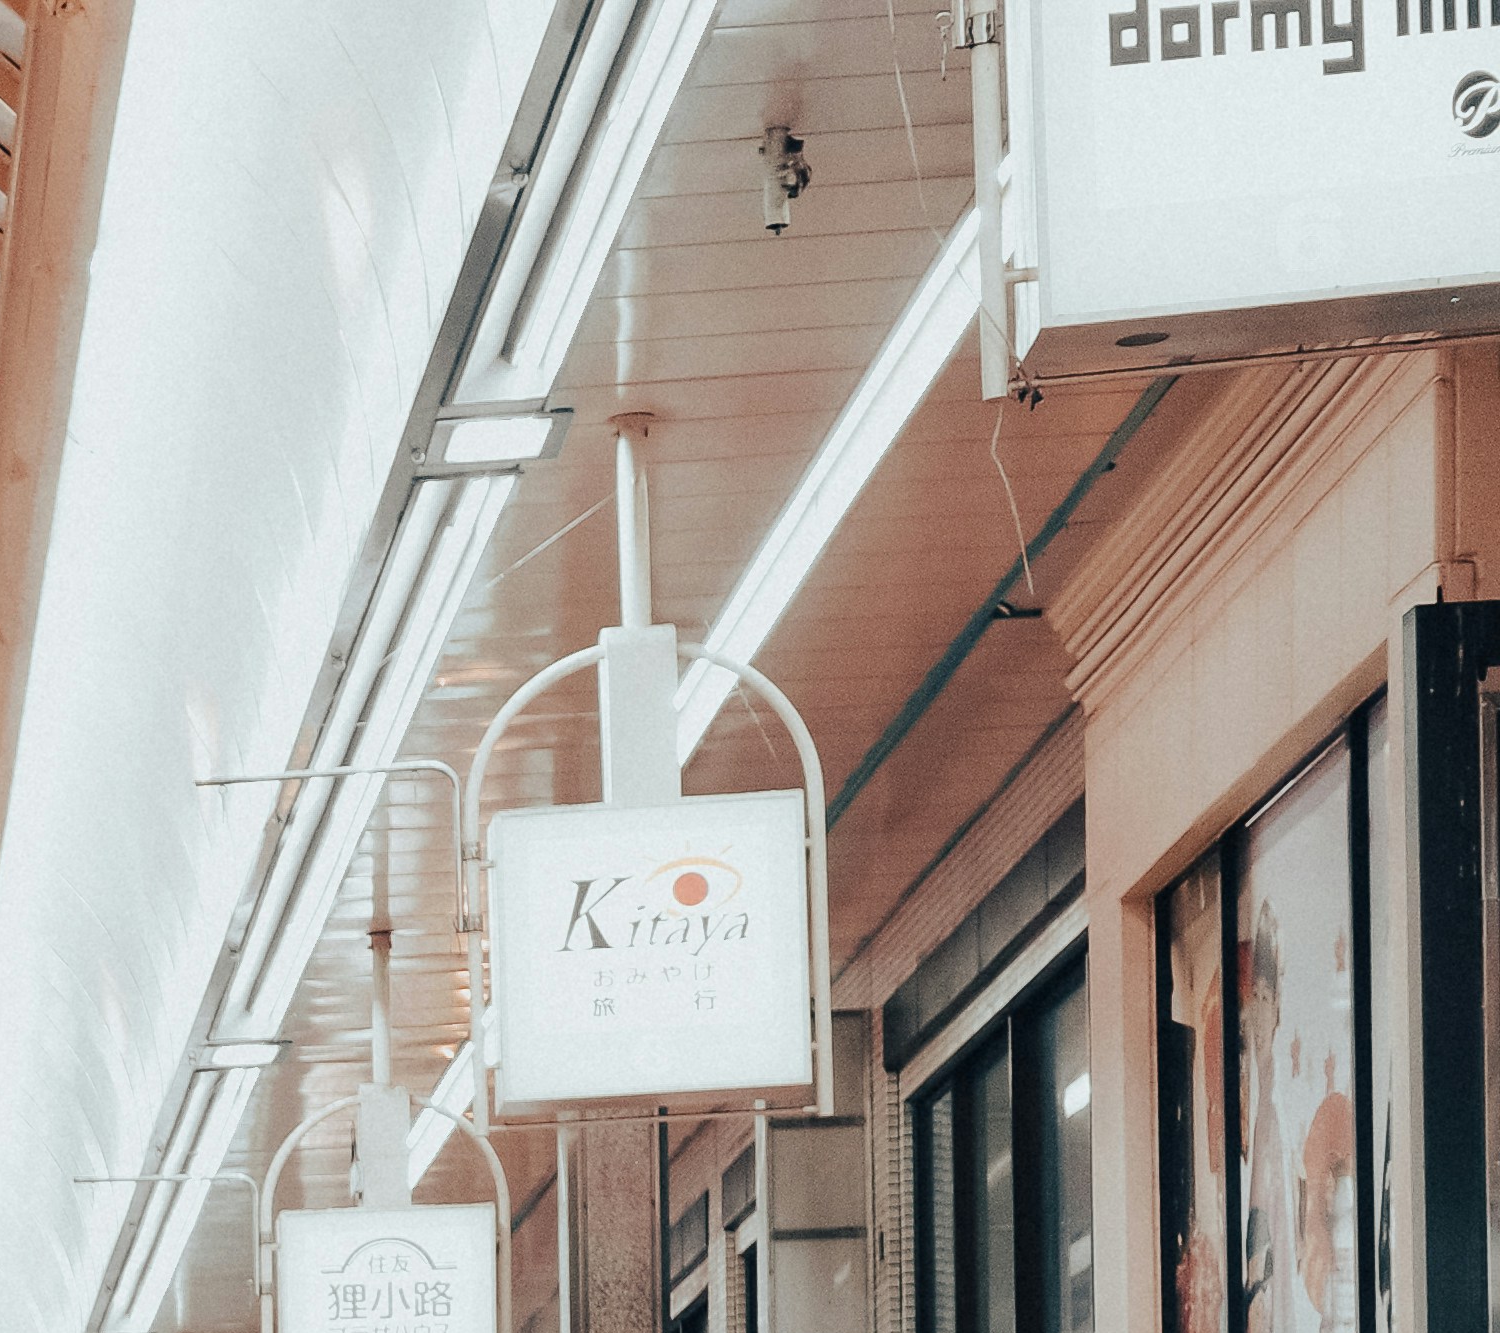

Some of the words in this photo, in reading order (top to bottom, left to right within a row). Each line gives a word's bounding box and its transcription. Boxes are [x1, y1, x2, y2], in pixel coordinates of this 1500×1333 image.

[1109, 0, 1366, 75] dormy
[555, 875, 750, 957] Kitaya
[327, 1281, 454, 1321] 狸小路
